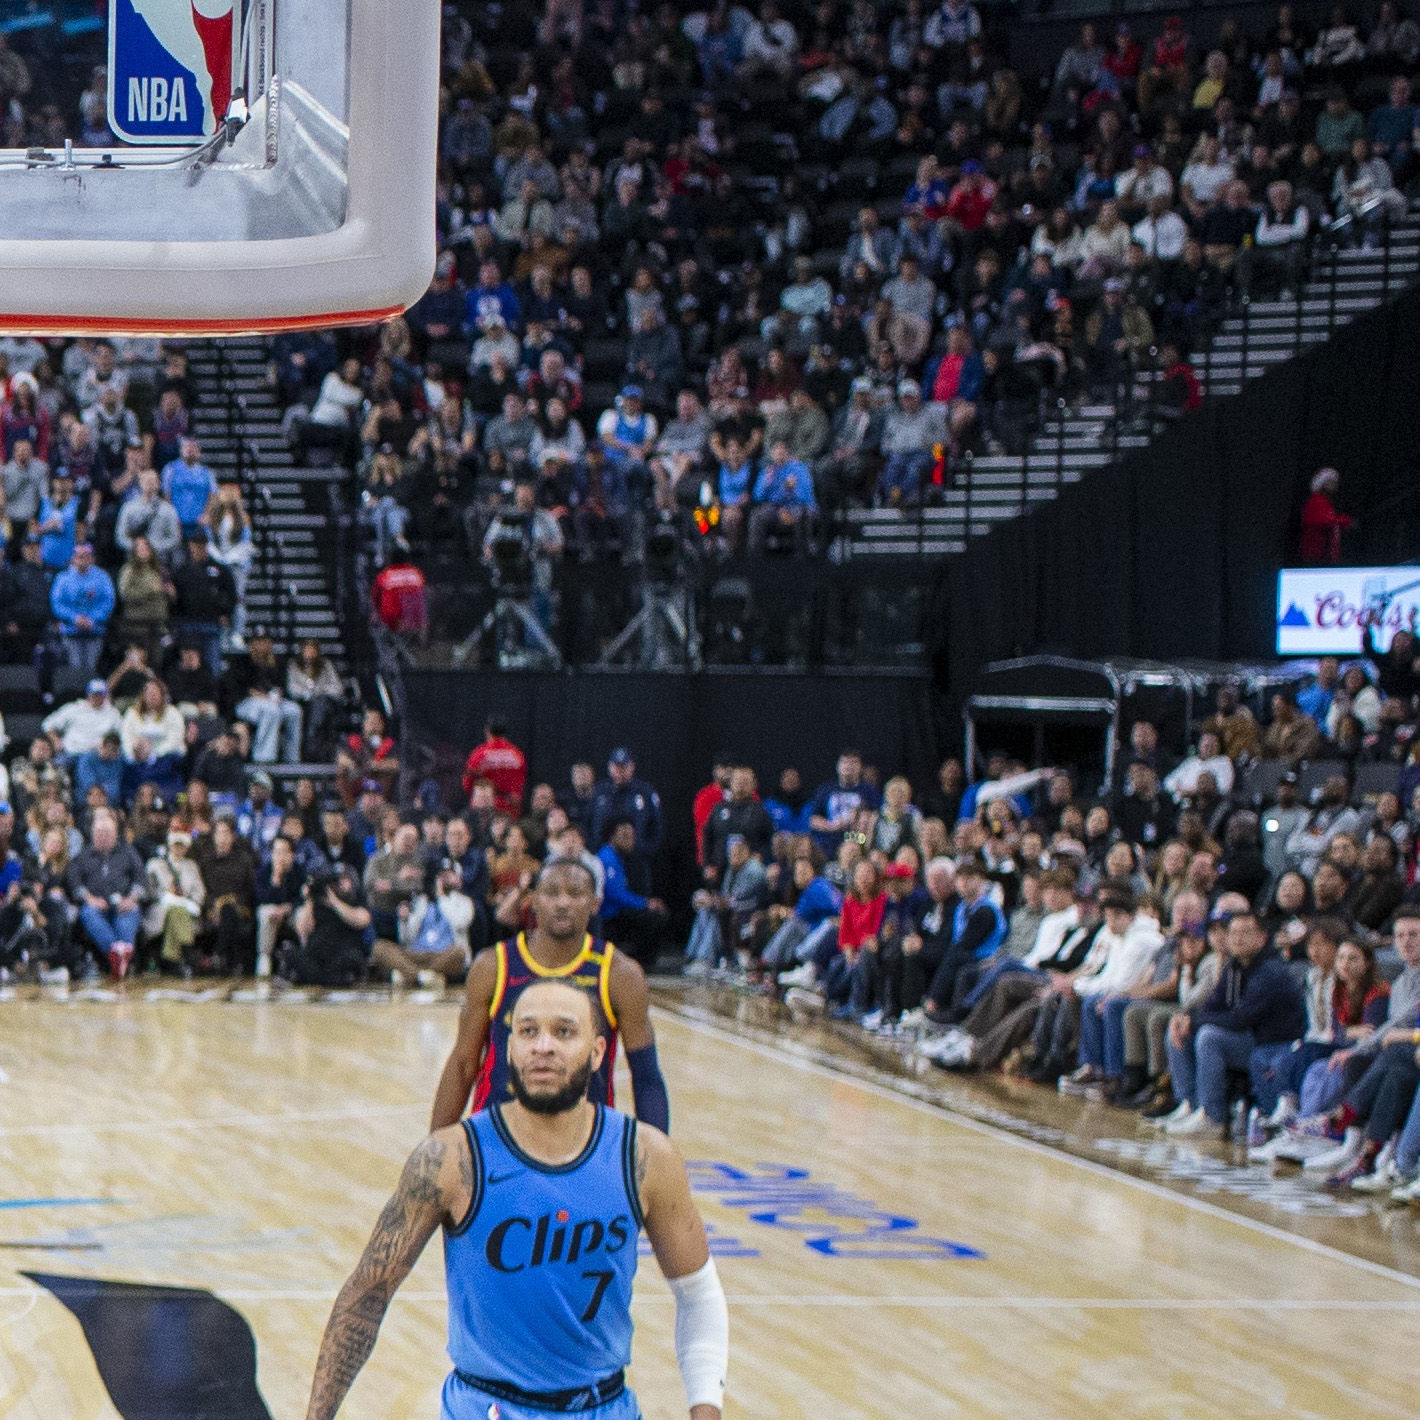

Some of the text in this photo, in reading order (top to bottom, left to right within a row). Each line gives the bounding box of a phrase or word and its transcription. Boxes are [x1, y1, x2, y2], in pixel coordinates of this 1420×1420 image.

[127, 77, 188, 123] NBA
[485, 1209, 632, 1274] Clips
[580, 1269, 616, 1323] 7
